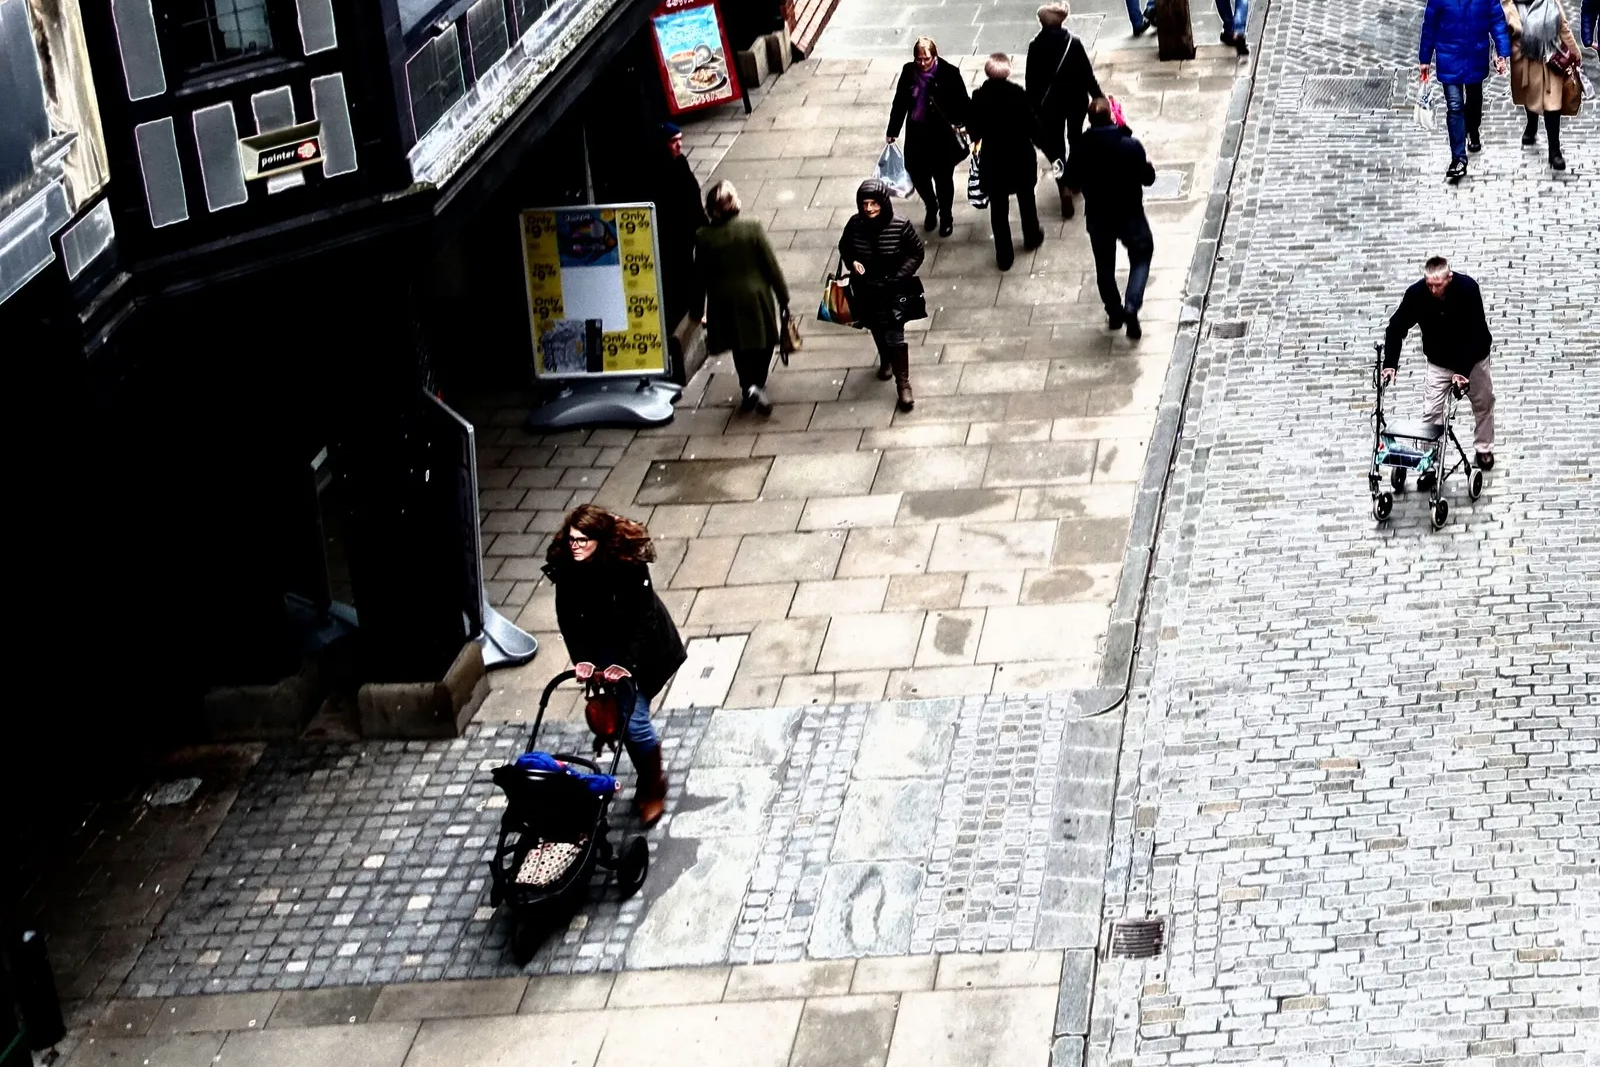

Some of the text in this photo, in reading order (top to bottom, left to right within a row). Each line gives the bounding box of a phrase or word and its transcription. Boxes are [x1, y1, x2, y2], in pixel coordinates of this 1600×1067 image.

[261, 149, 296, 167] pointer
[527, 215, 552, 227] Only
[621, 211, 646, 222] Only
[625, 253, 650, 265] Only
[534, 296, 560, 308] Only
[629, 295, 655, 307] Only
[603, 334, 628, 346] Only
[633, 333, 658, 344] Only
